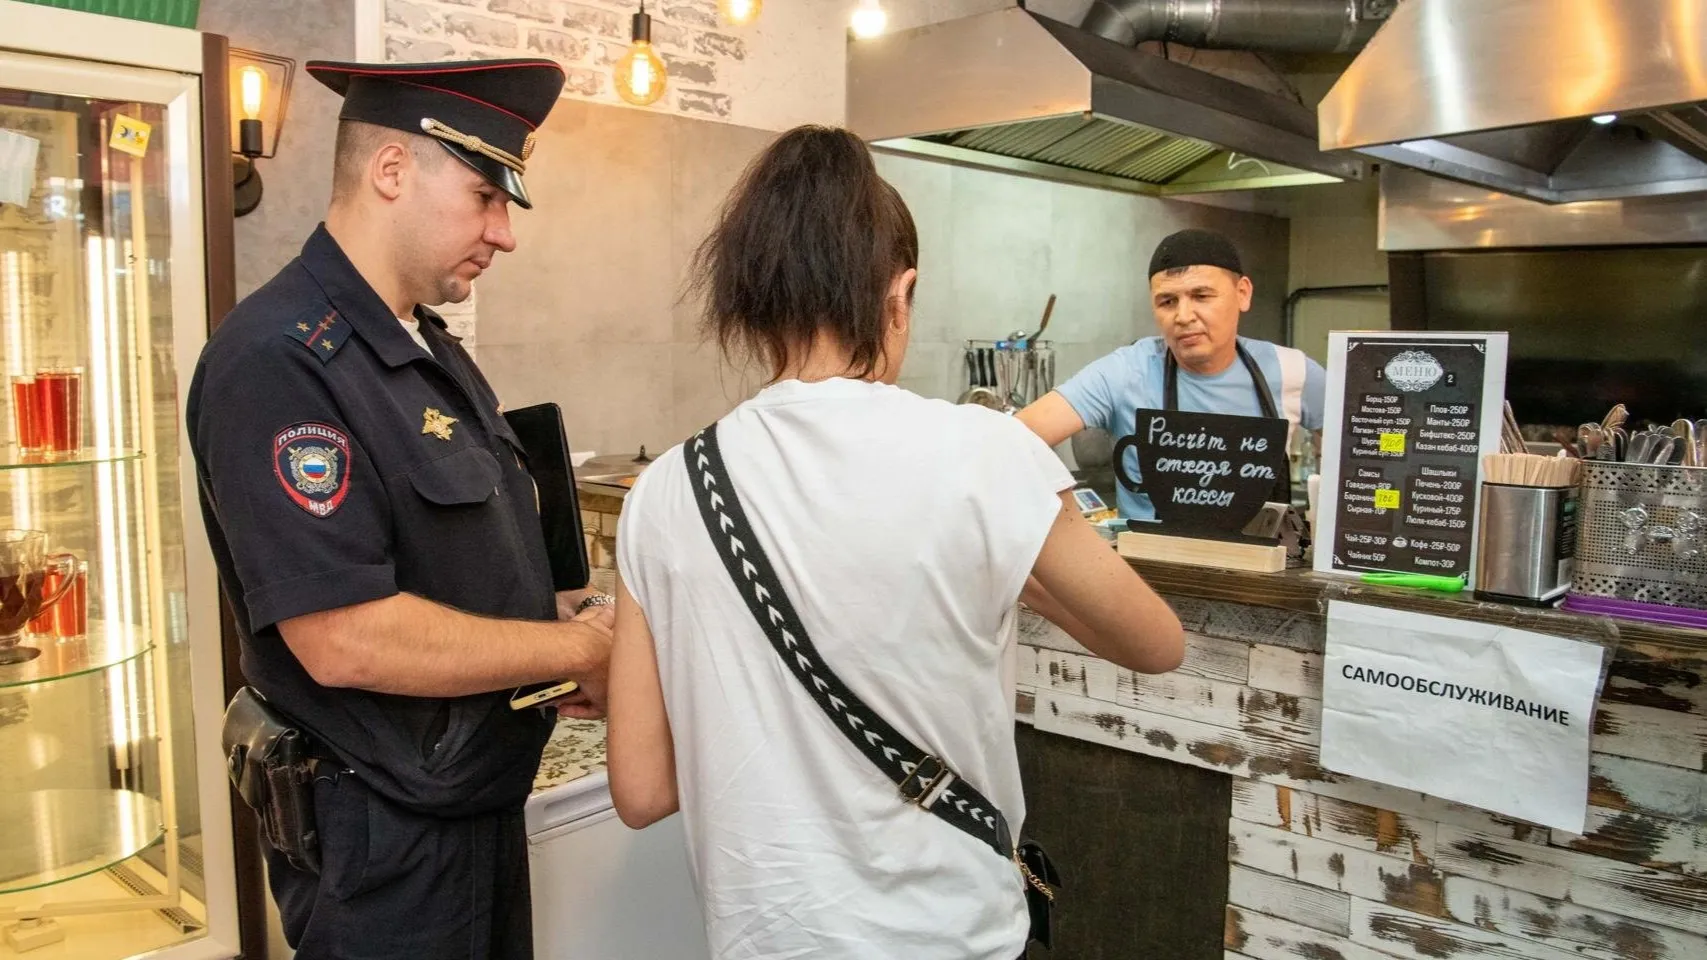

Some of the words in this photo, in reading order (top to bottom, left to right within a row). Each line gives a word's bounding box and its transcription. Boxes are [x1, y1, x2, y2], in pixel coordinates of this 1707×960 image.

[1393, 365, 1437, 377] МЕНЮ
[1447, 374, 1454, 383] 2
[278, 426, 346, 447] ПОЛИЦИЯ
[1240, 437, 1268, 452] не
[1156, 457, 1232, 487] отходя
[1240, 463, 1276, 480] от
[1421, 466, 1457, 477] Шашлыки
[1172, 486, 1236, 507] кассы
[308, 500, 334, 516] МВД
[1341, 664, 1570, 727] САМООБСЛУЖИВАНИЕ
